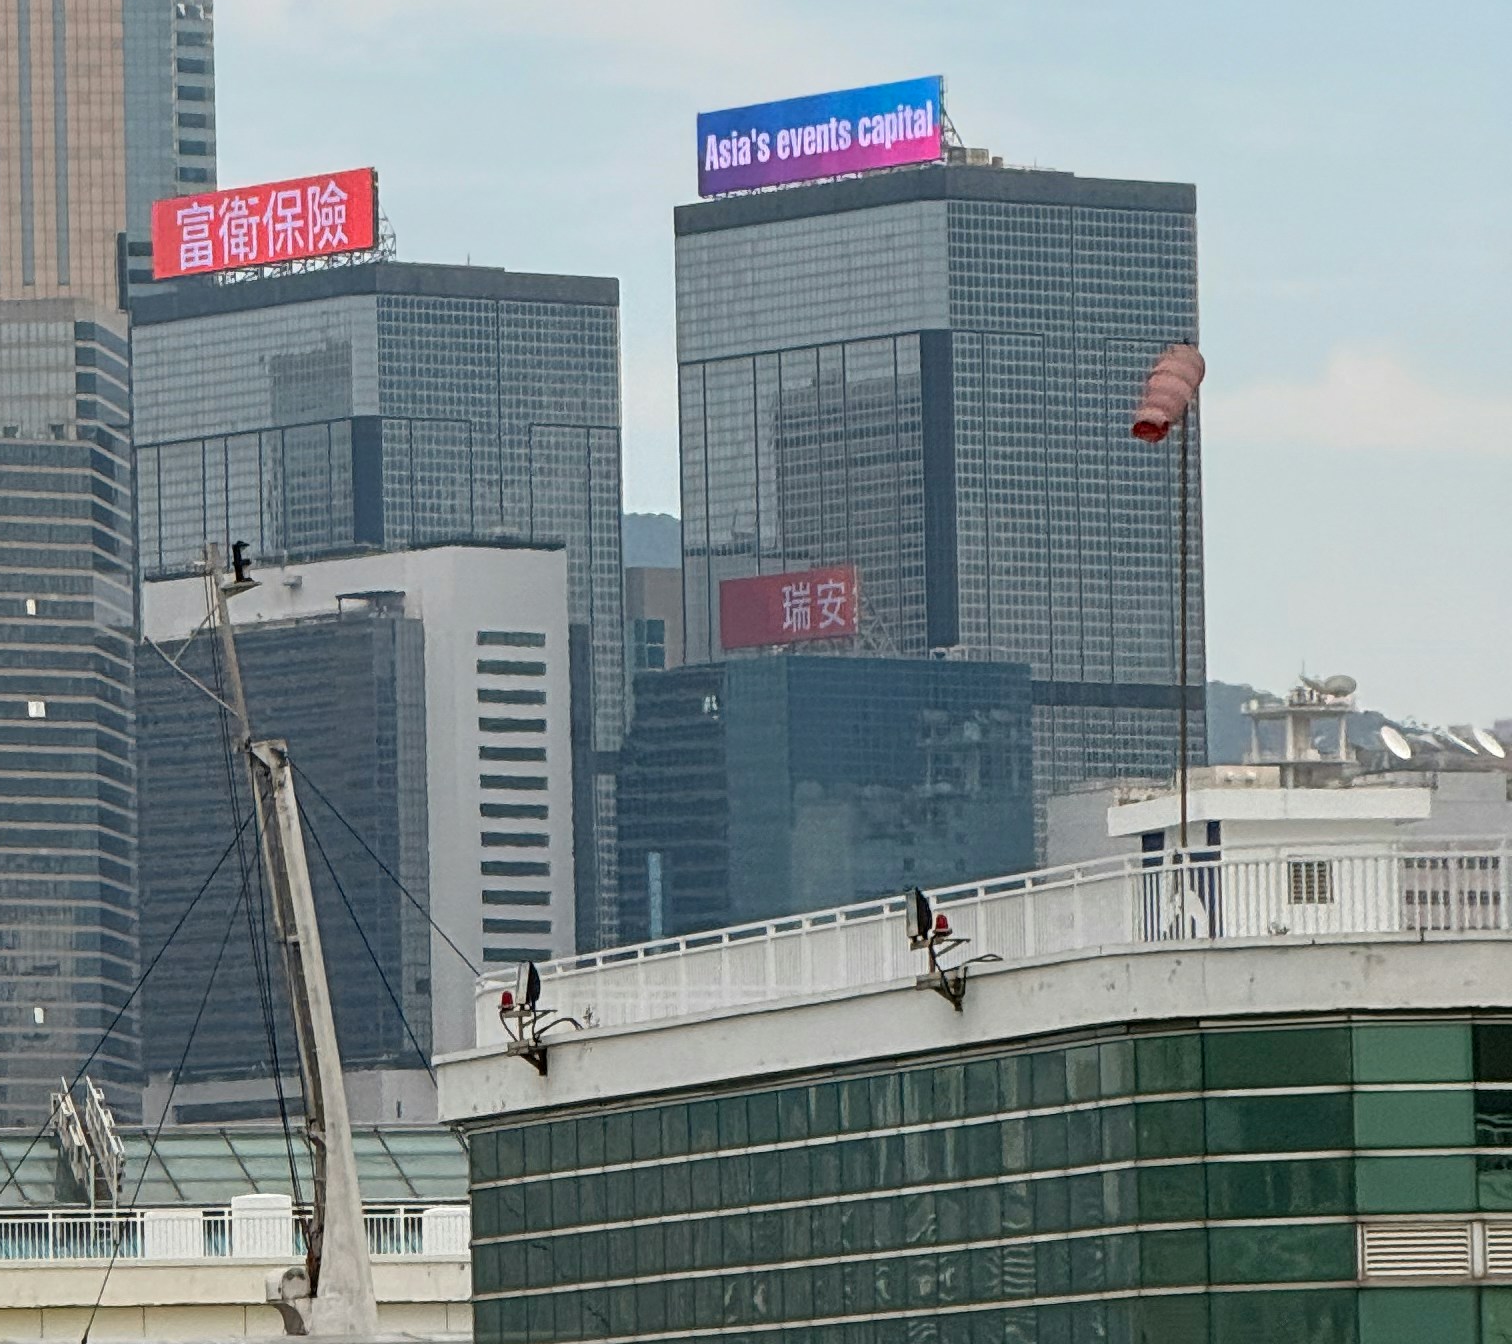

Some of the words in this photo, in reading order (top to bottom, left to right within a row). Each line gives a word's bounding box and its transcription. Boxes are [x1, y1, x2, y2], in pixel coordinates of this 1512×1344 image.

[705, 127, 770, 171] Asia's
[776, 117, 851, 160] events
[857, 100, 934, 150] capital
[176, 179, 349, 271] 富衛保險
[781, 576, 858, 633] 瑞安
